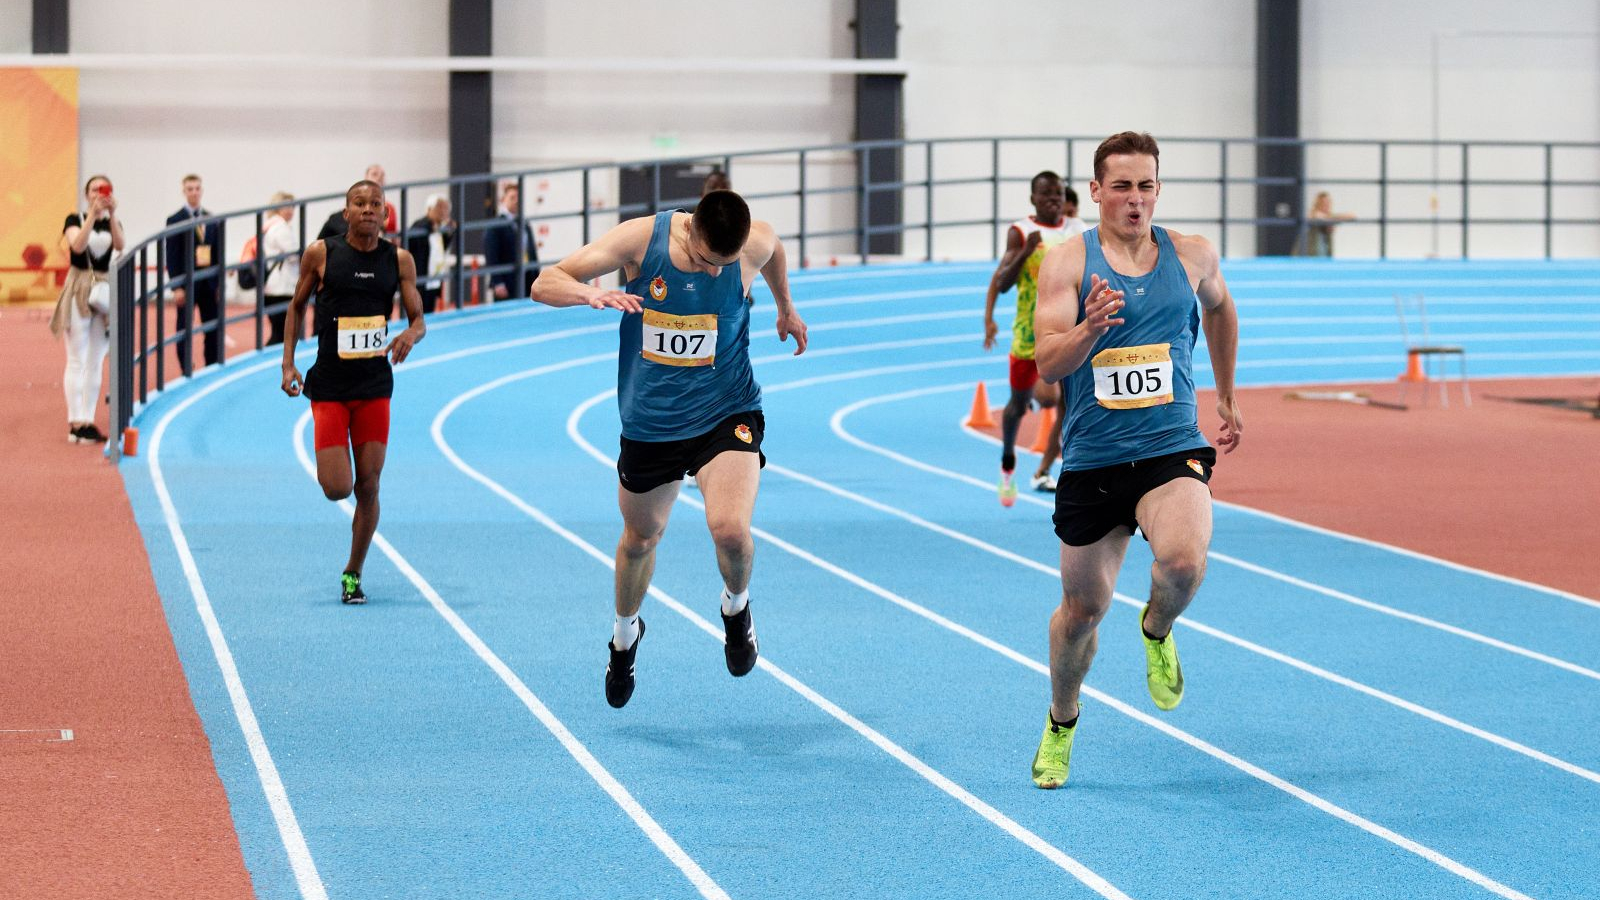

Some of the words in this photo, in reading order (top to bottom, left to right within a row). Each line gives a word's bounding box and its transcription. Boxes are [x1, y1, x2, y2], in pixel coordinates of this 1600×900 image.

[349, 331, 382, 349] 118
[654, 332, 706, 355] 107
[1107, 367, 1162, 396] 105
